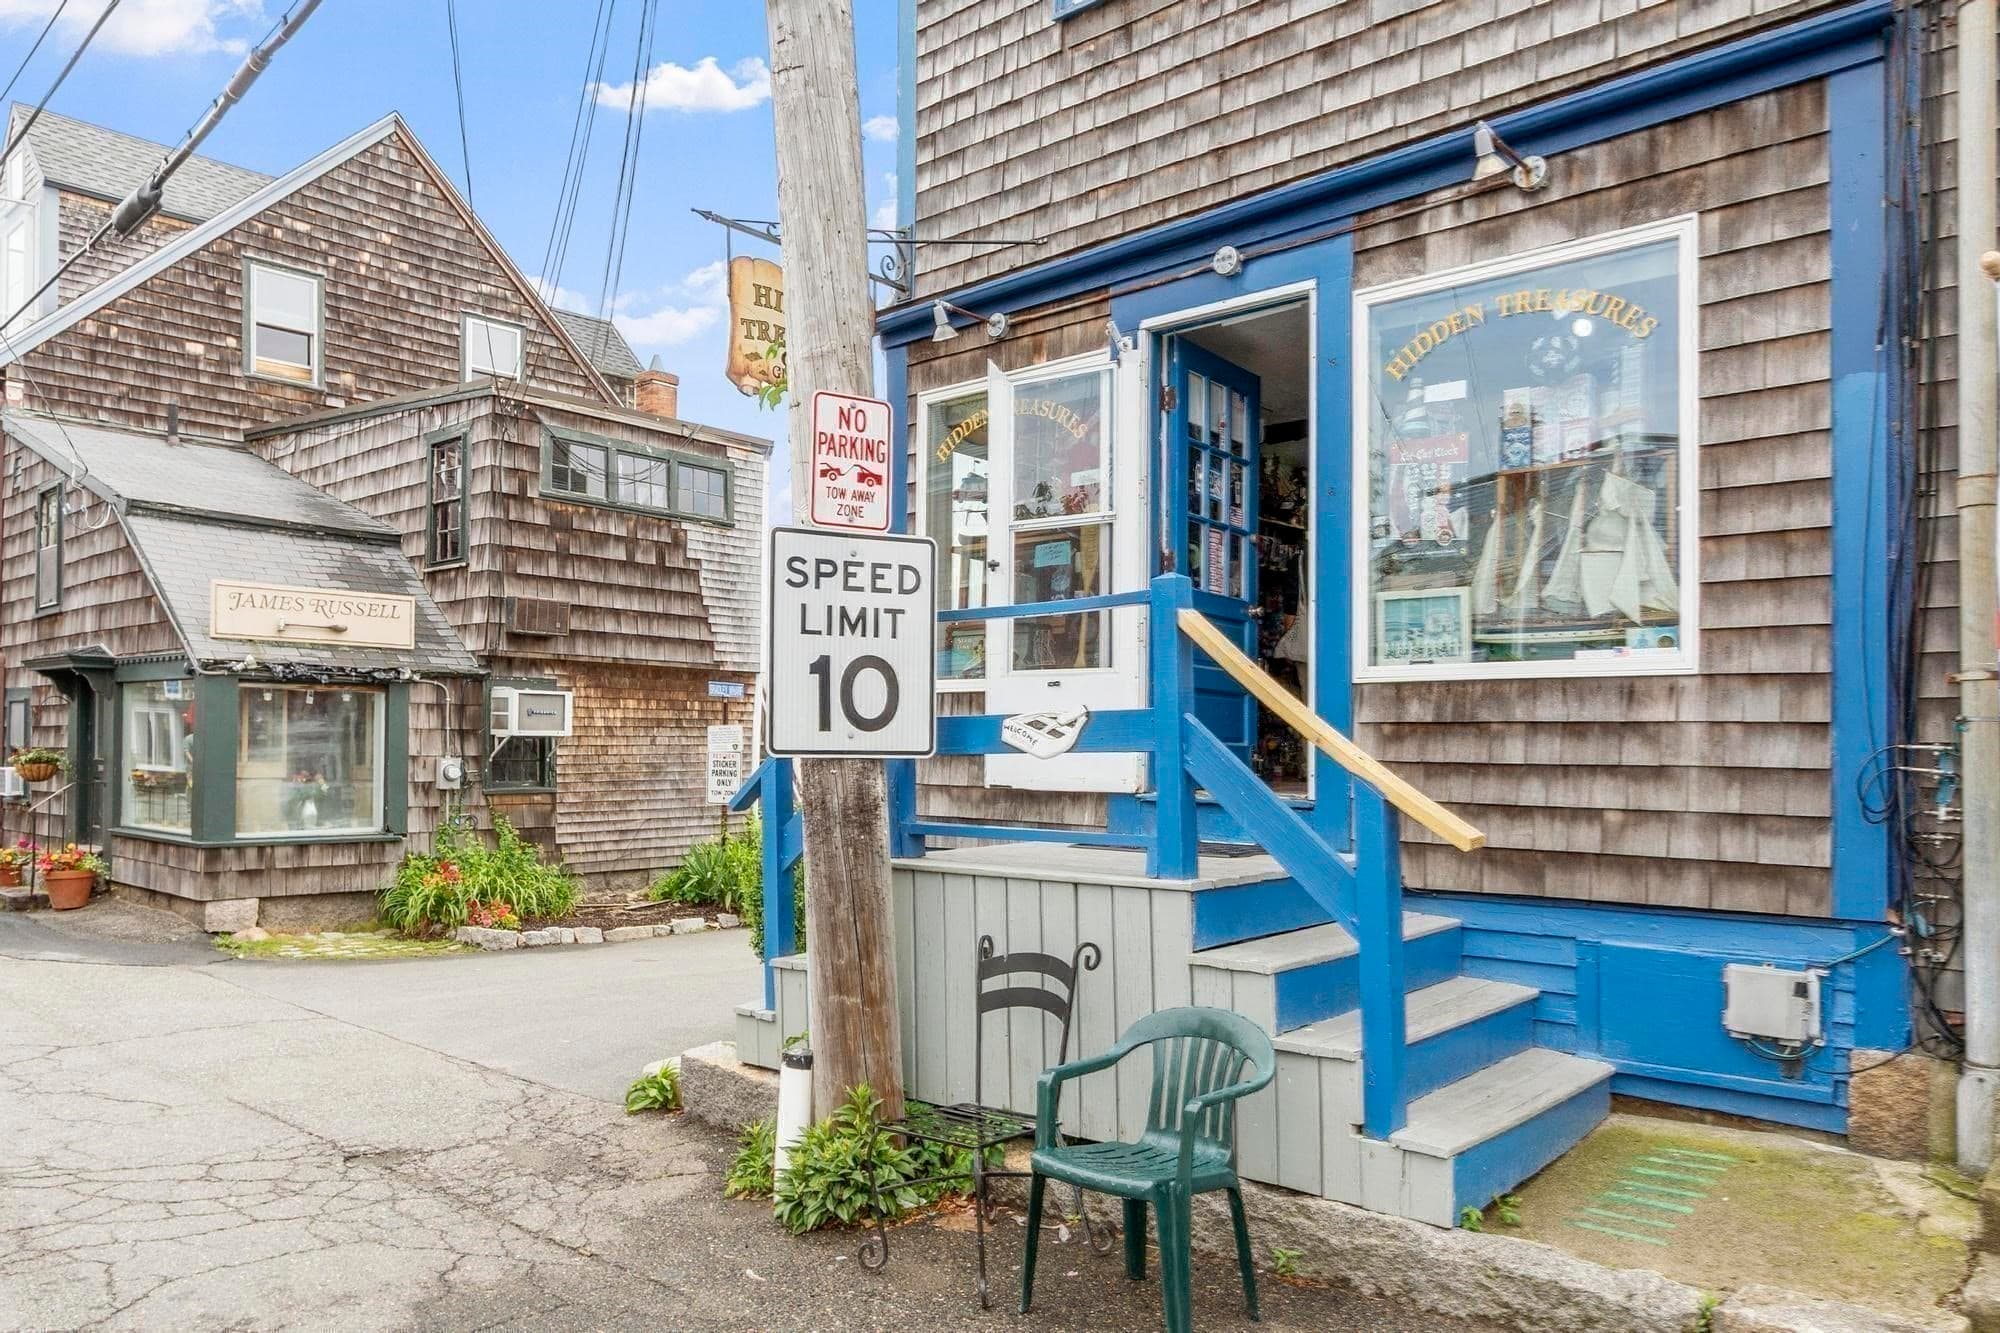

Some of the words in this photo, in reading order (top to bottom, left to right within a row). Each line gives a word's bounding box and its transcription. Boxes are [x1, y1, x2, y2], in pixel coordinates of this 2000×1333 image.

[753, 283, 784, 314] HI
[740, 317, 786, 348] TRE
[1384, 301, 1487, 382] HIDDEN
[1495, 288, 1659, 339] TREASURES
[839, 405, 867, 434] NO
[1014, 398, 1088, 439] EASURES
[818, 431, 886, 463] PARKING
[826, 486, 847, 500] TOW
[851, 489, 876, 503] AWAY
[836, 502, 865, 519] ZONE
[785, 555, 921, 595] SPEED
[228, 591, 305, 612] JAMES
[308, 598, 401, 619] RUSSELL
[800, 602, 905, 639] LIMIT
[808, 654, 899, 732] 10
[1004, 724, 1039, 746] WELCOME
[711, 769, 738, 777] PARKING
[712, 760, 737, 768] STICKER
[716, 778, 732, 787] ONLY
